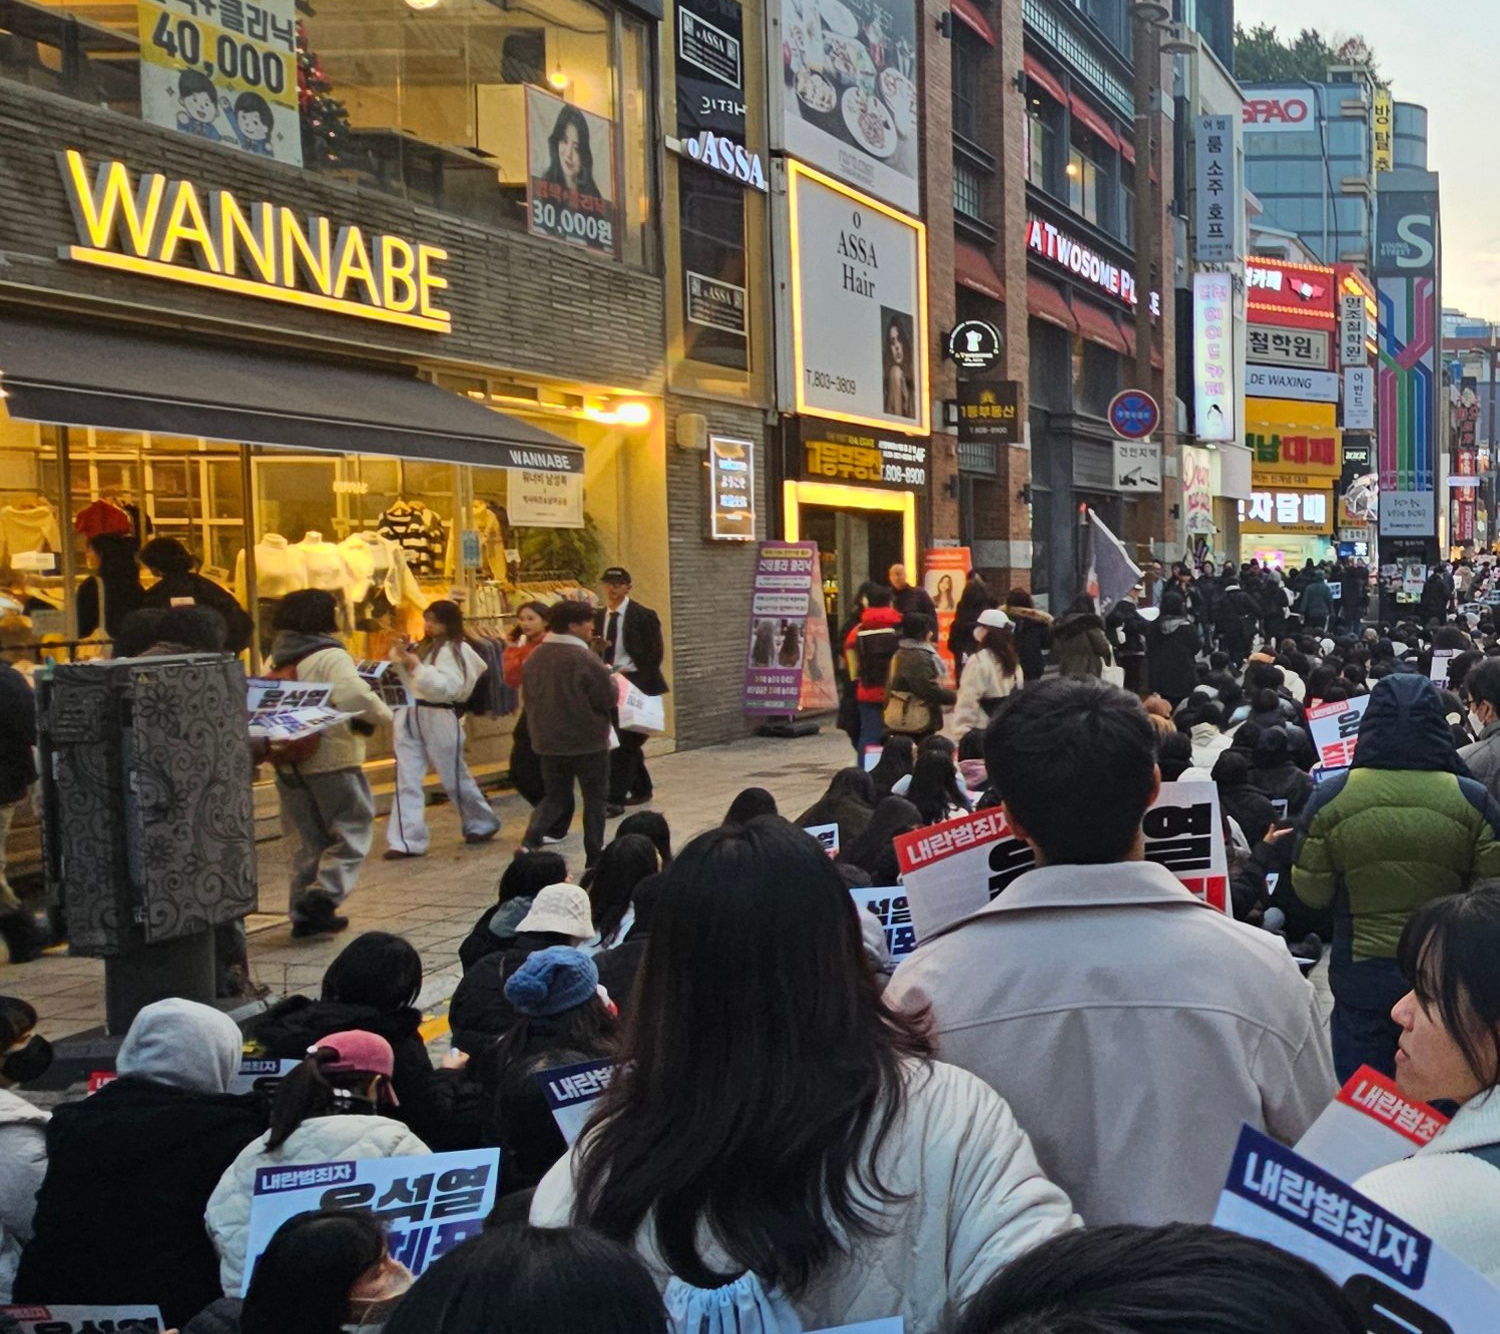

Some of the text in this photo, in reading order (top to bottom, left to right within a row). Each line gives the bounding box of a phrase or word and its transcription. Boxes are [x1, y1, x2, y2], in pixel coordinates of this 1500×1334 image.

[153, 11, 284, 94] 40,000
[65, 149, 451, 322] WANNABE
[532, 199, 612, 245] 30,000원
[1207, 203, 1224, 238] 호프
[837, 230, 879, 270] ASSA
[1043, 223, 1118, 292] TWOSOME
[842, 263, 875, 299] Hair
[1268, 375, 1312, 389] WAXING
[509, 449, 571, 470] WANNABE
[1246, 433, 1335, 465] 남대패
[261, 1164, 352, 1192] 내란범죄자
[1242, 1151, 1420, 1277] 내란범죄자
